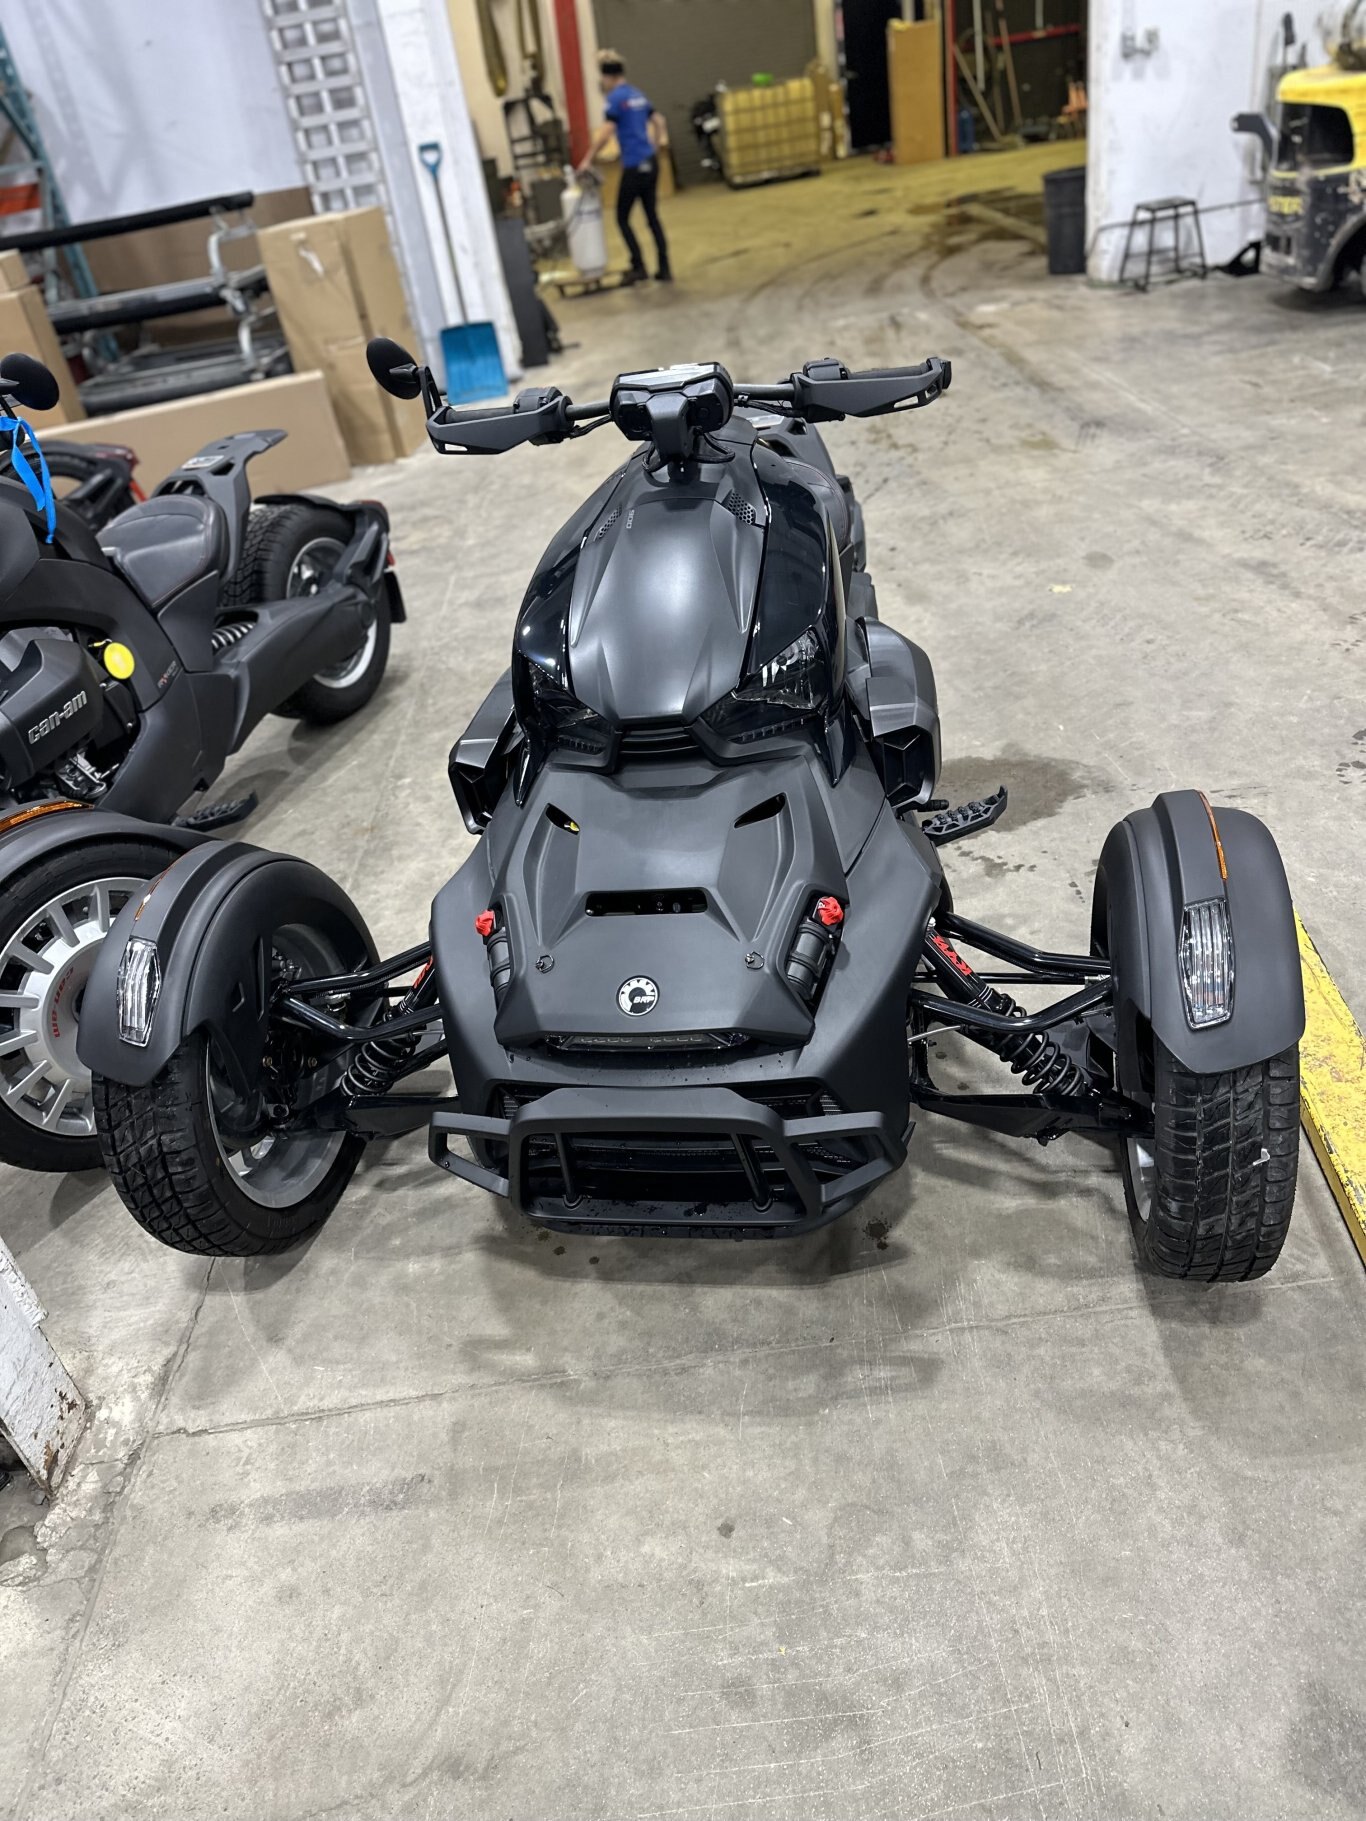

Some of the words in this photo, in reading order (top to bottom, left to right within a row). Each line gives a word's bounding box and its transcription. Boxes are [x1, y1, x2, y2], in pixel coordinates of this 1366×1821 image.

[28, 690, 88, 745] can-am
[932, 935, 973, 976] KYB
[51, 967, 74, 1038] can-am
[633, 995, 656, 1004] BRP
